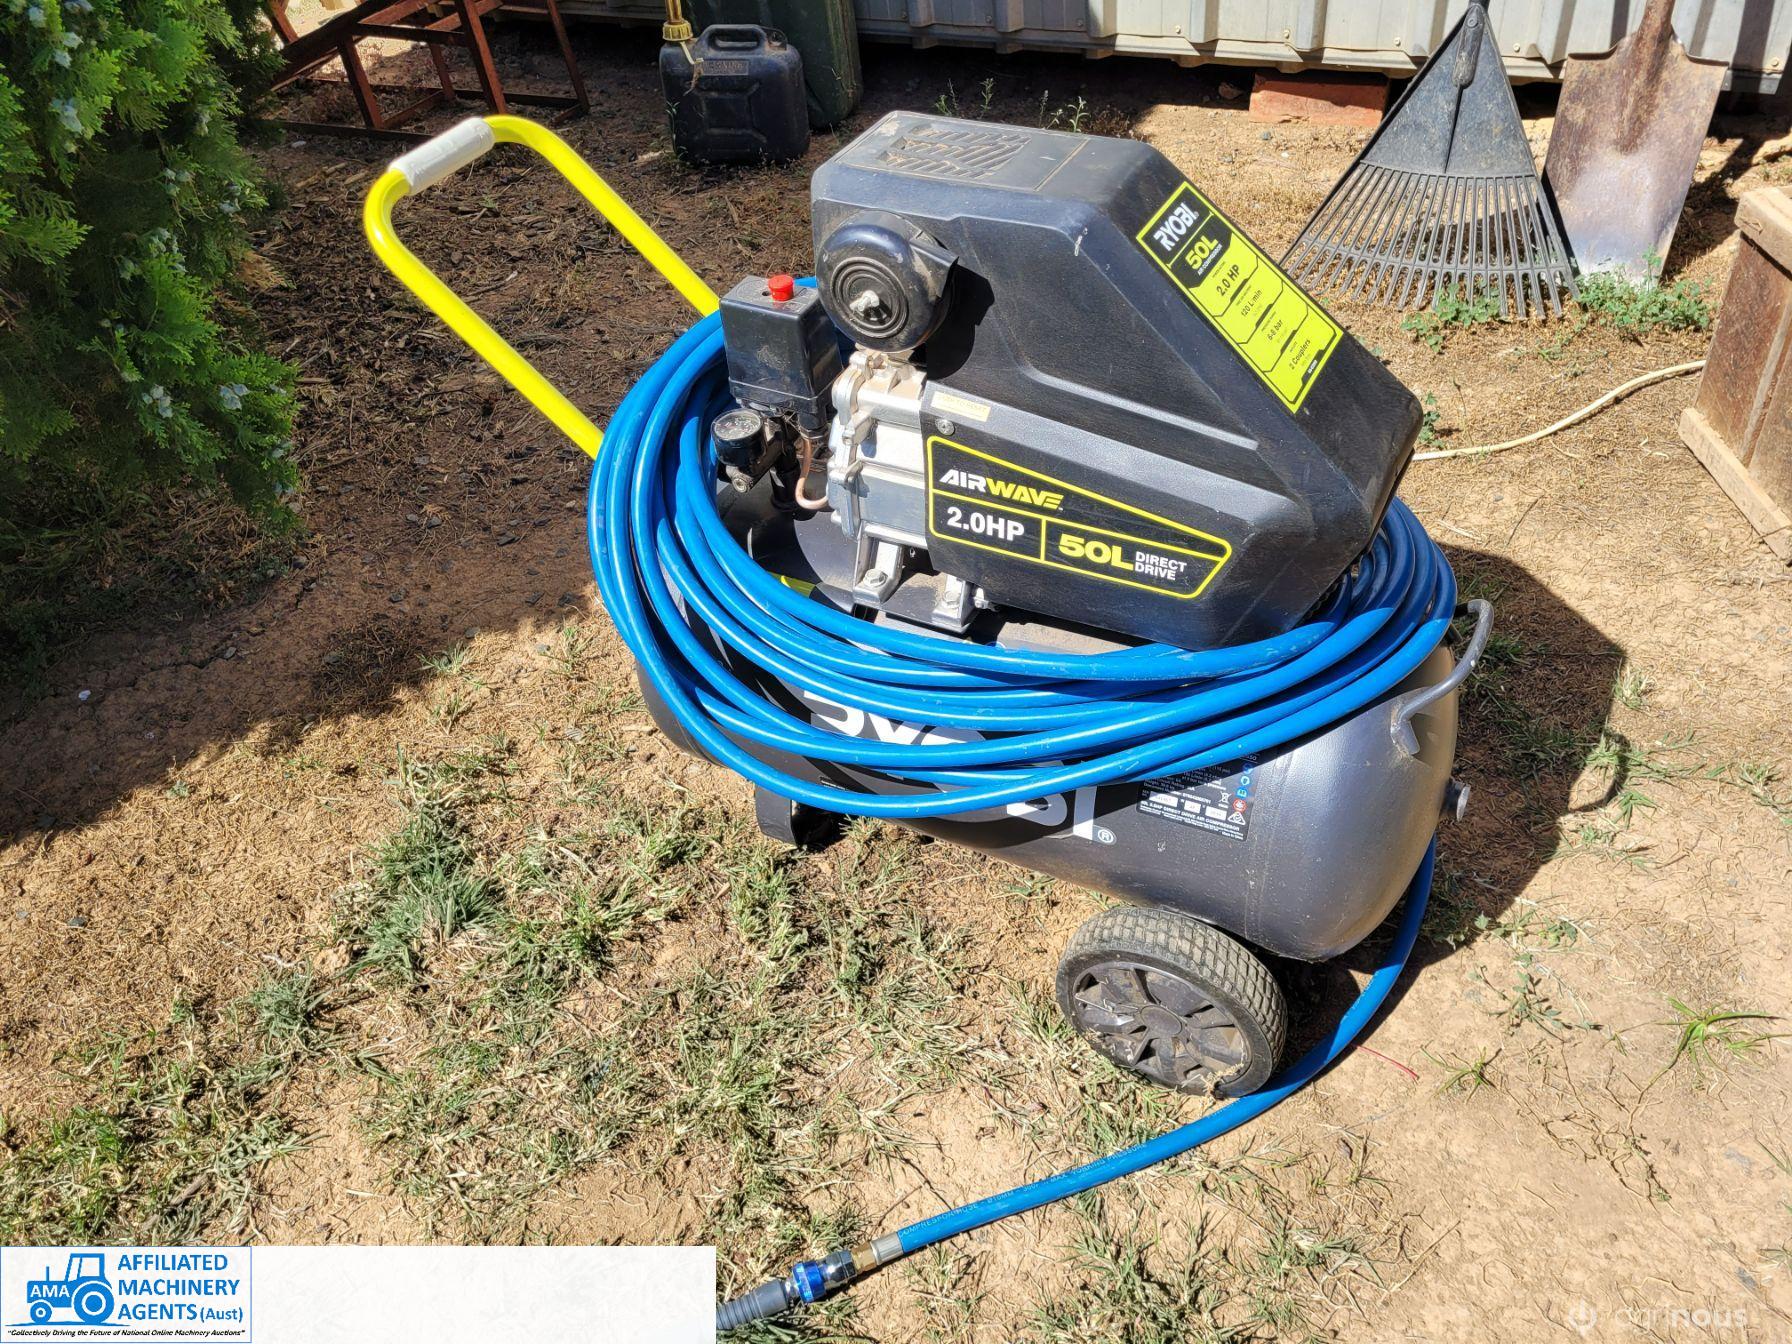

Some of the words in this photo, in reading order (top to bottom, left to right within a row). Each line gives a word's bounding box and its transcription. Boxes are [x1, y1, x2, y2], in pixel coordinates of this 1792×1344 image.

[1153, 202, 1198, 251] RYOBI
[1185, 235, 1218, 269] 50L
[1216, 278, 1231, 296] 2.0
[1227, 264, 1240, 281] HP
[1274, 319, 1283, 331] bar
[1292, 339, 1311, 365] Couplers
[939, 469, 1064, 511] AIRWAVE
[947, 506, 1025, 541] 2.0HP
[1058, 533, 1135, 571] 50L
[1135, 550, 1187, 573] DIRECT
[1134, 561, 1176, 581] DRIVE
